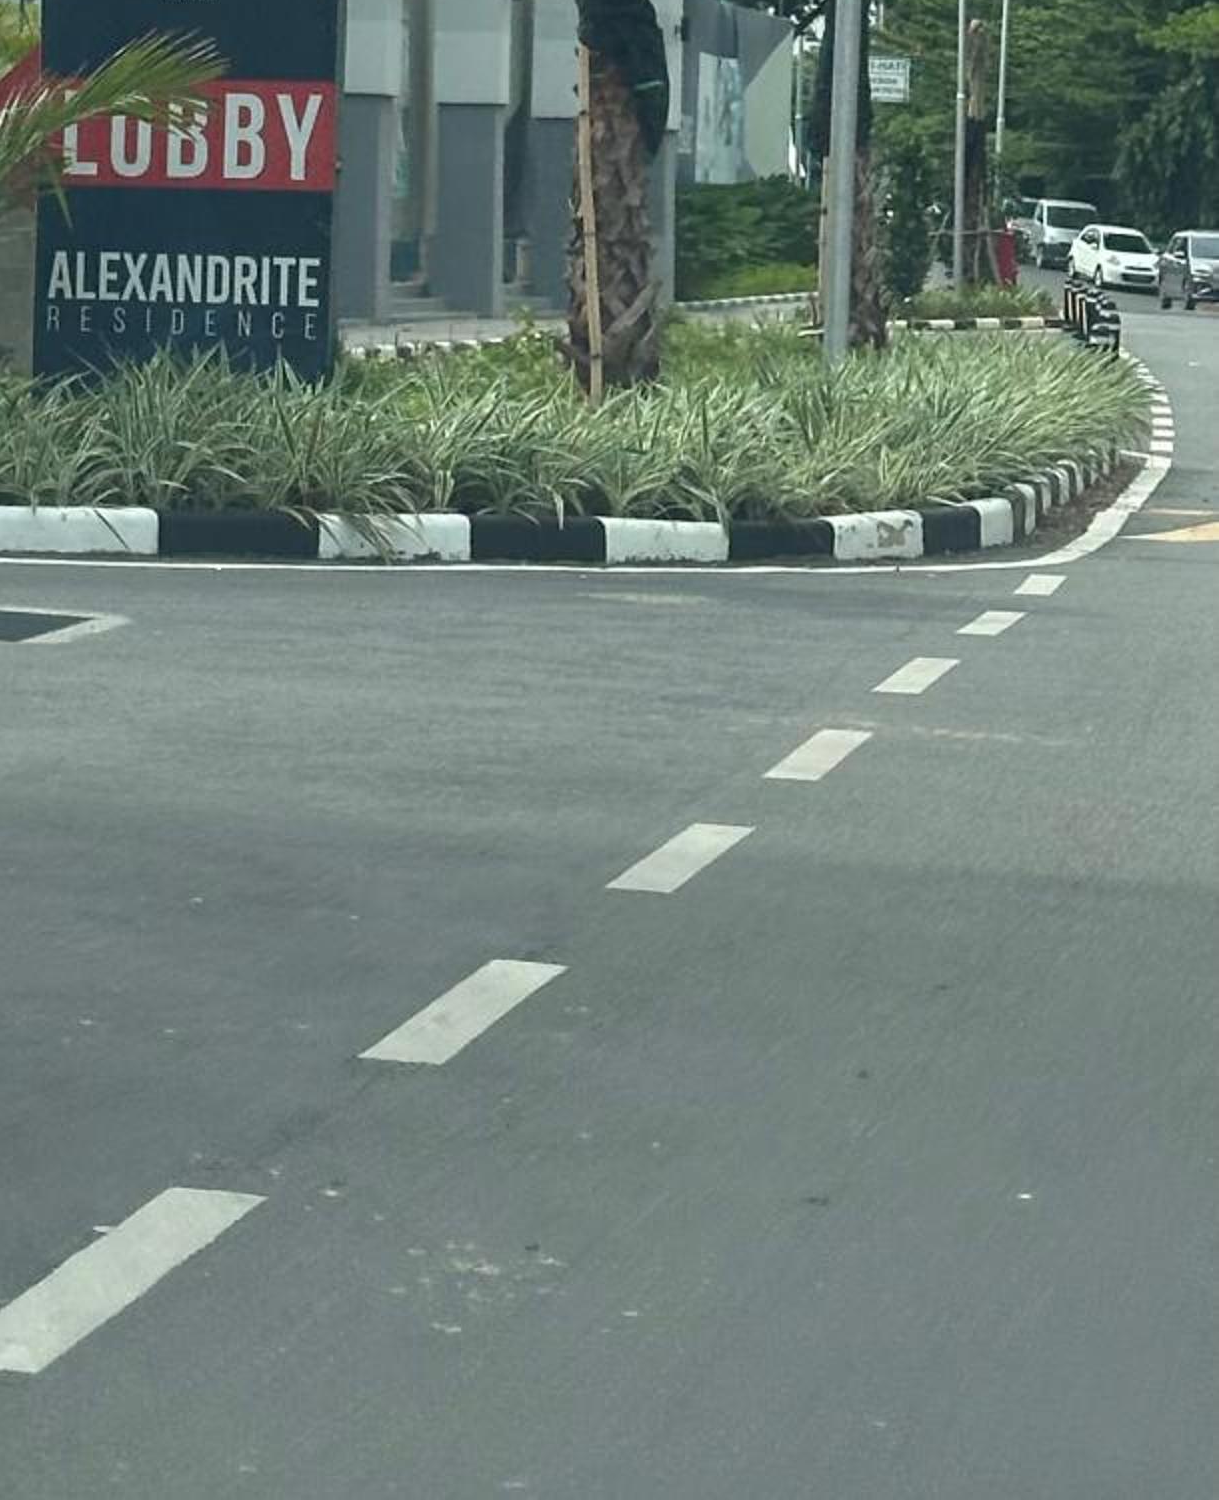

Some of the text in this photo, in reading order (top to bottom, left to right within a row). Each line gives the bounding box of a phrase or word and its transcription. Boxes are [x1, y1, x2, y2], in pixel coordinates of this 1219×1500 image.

[62, 90, 323, 181] LOBBY
[48, 251, 321, 308] ALEXANDRITE
[46, 307, 318, 341] RESIDENCE
